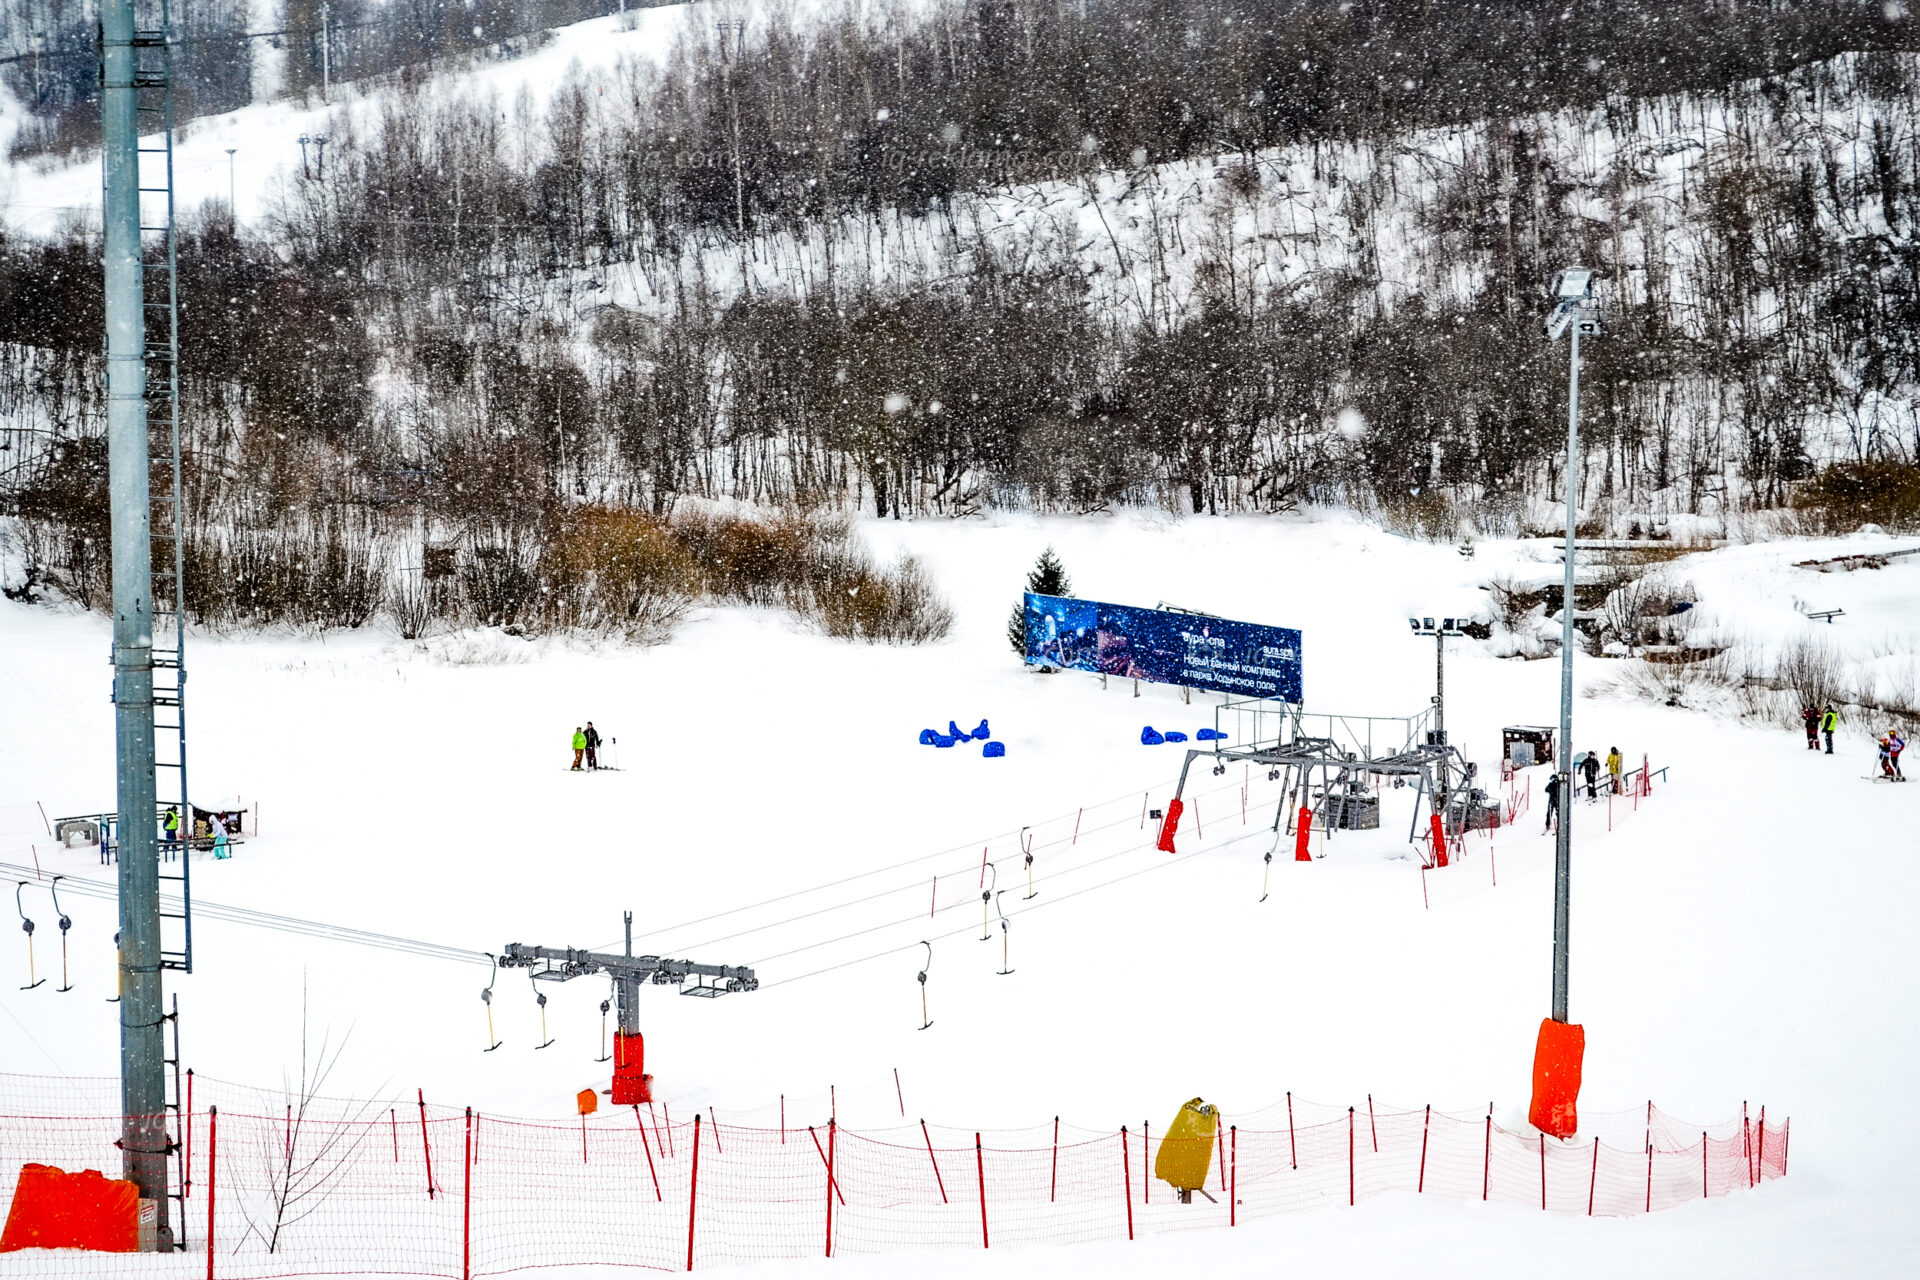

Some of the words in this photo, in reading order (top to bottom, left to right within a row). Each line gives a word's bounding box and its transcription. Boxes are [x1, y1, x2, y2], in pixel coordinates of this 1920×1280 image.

[1263, 645, 1294, 658] aura.spa
[1183, 653, 1209, 667] Новый
[1211, 656, 1240, 671] банный
[1241, 665, 1281, 678] комплекс
[1213, 672, 1254, 687] Ходынское
